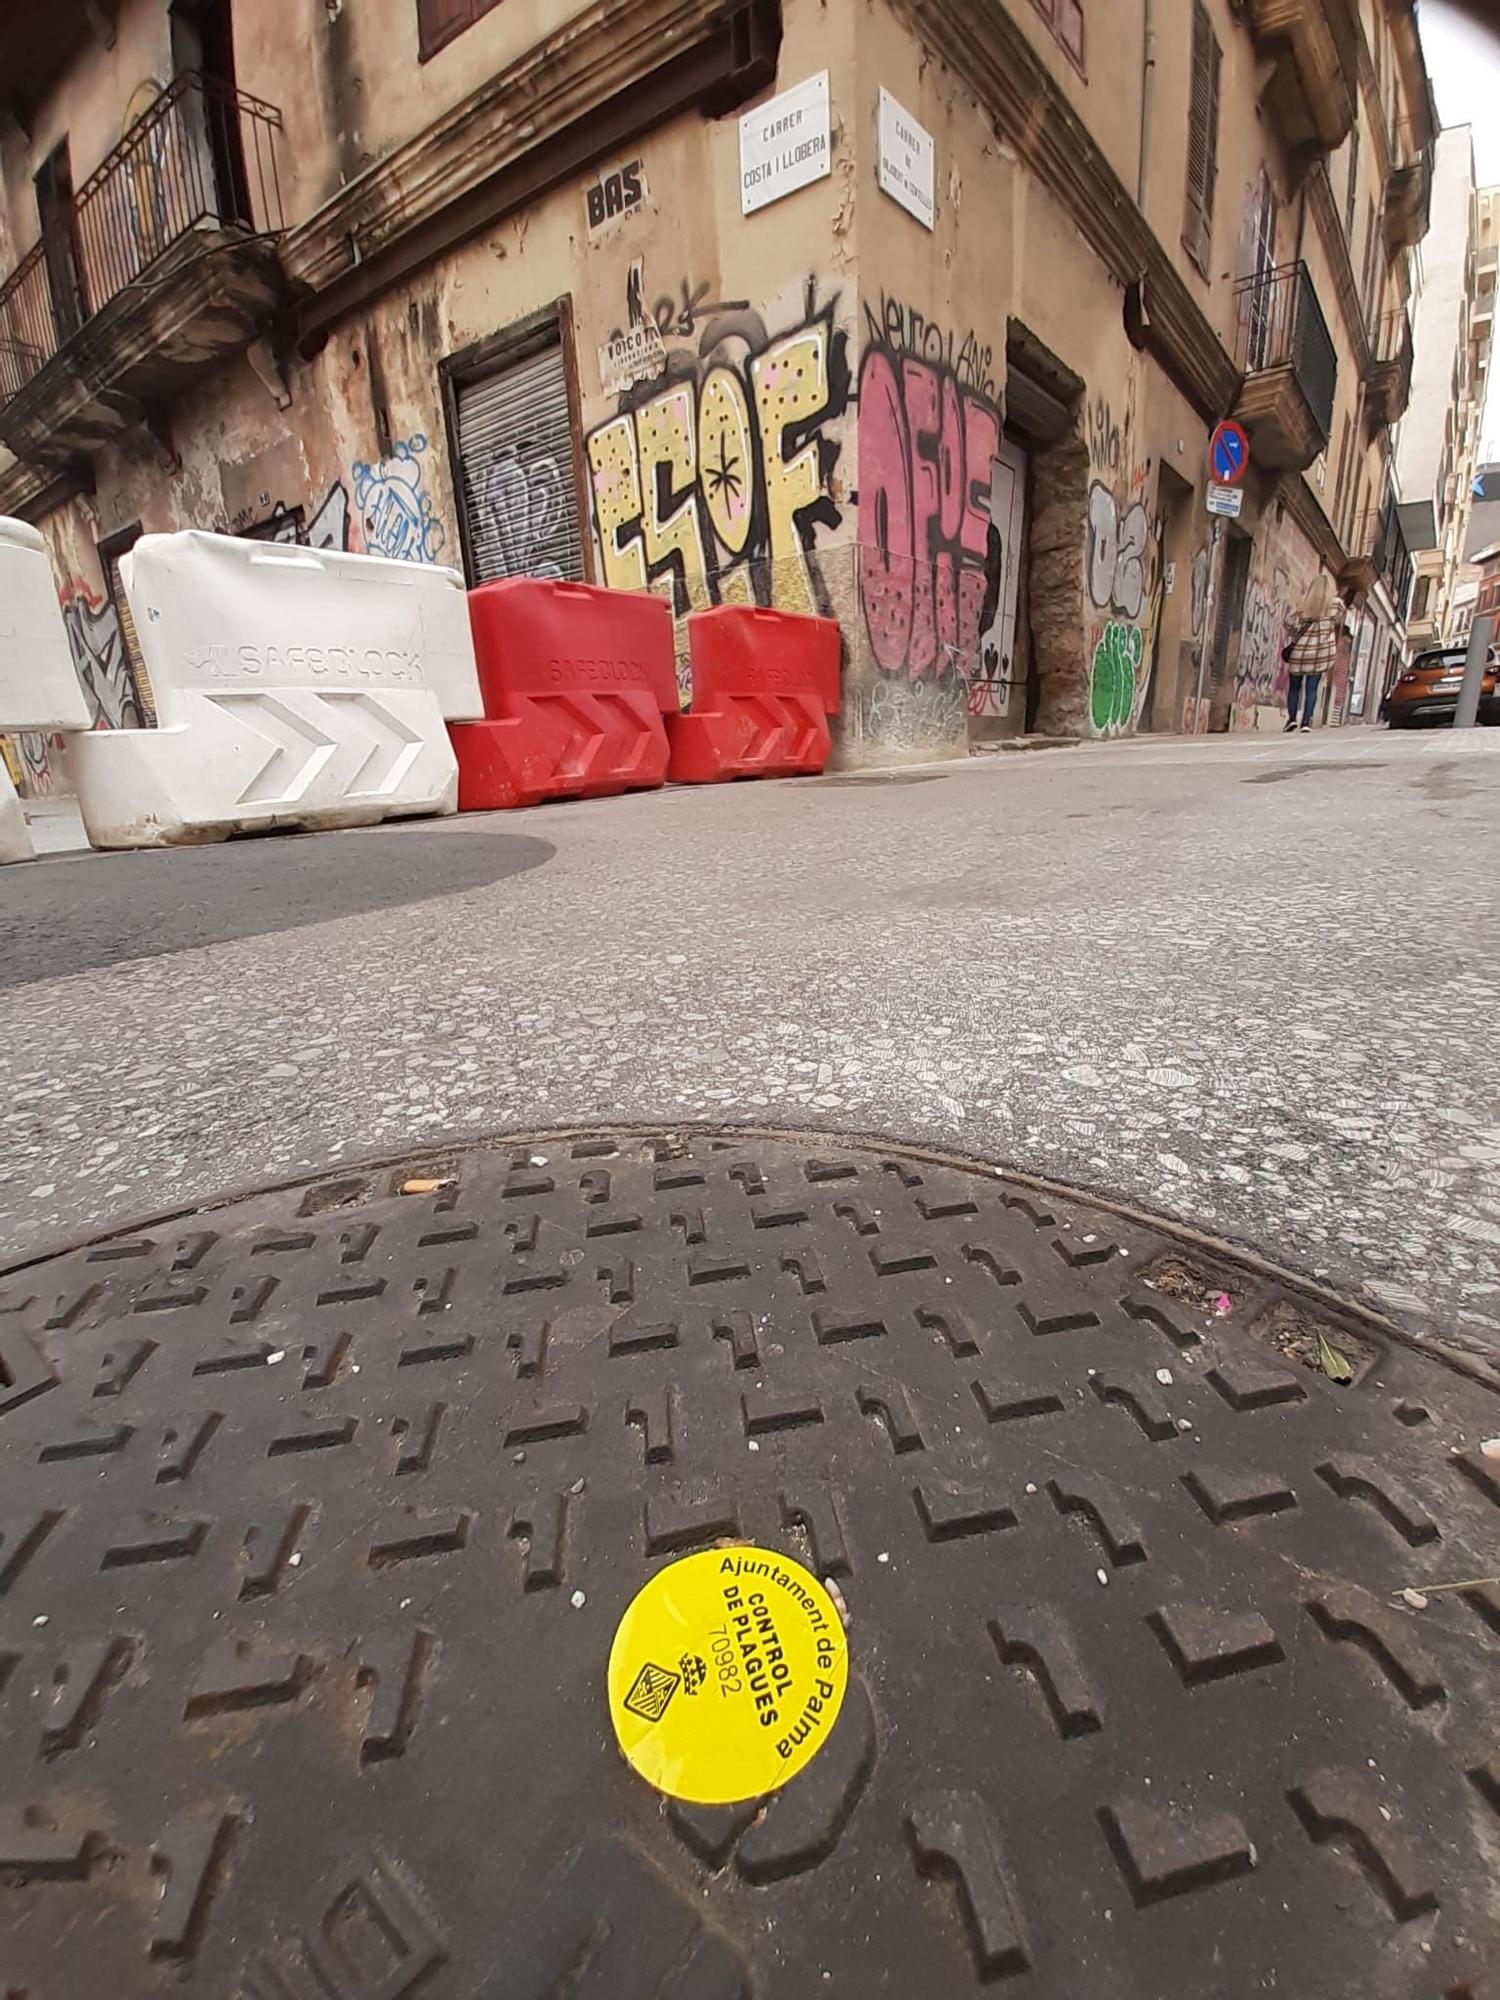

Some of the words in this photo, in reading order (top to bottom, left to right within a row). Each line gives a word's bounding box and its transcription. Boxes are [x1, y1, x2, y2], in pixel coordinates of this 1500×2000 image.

[743, 160, 772, 190] COSTA
[782, 133, 826, 170] LLOBERA
[762, 109, 803, 143] CARRER
[719, 1556, 829, 1633] Ajuntament
[722, 1584, 745, 1612] DE
[707, 1622, 743, 1699] 70982
[731, 1613, 779, 1728] PLAGUES
[748, 1593, 793, 1697] CONTROL
[816, 1637, 837, 1669] de
[775, 1678, 834, 1759] Palma
